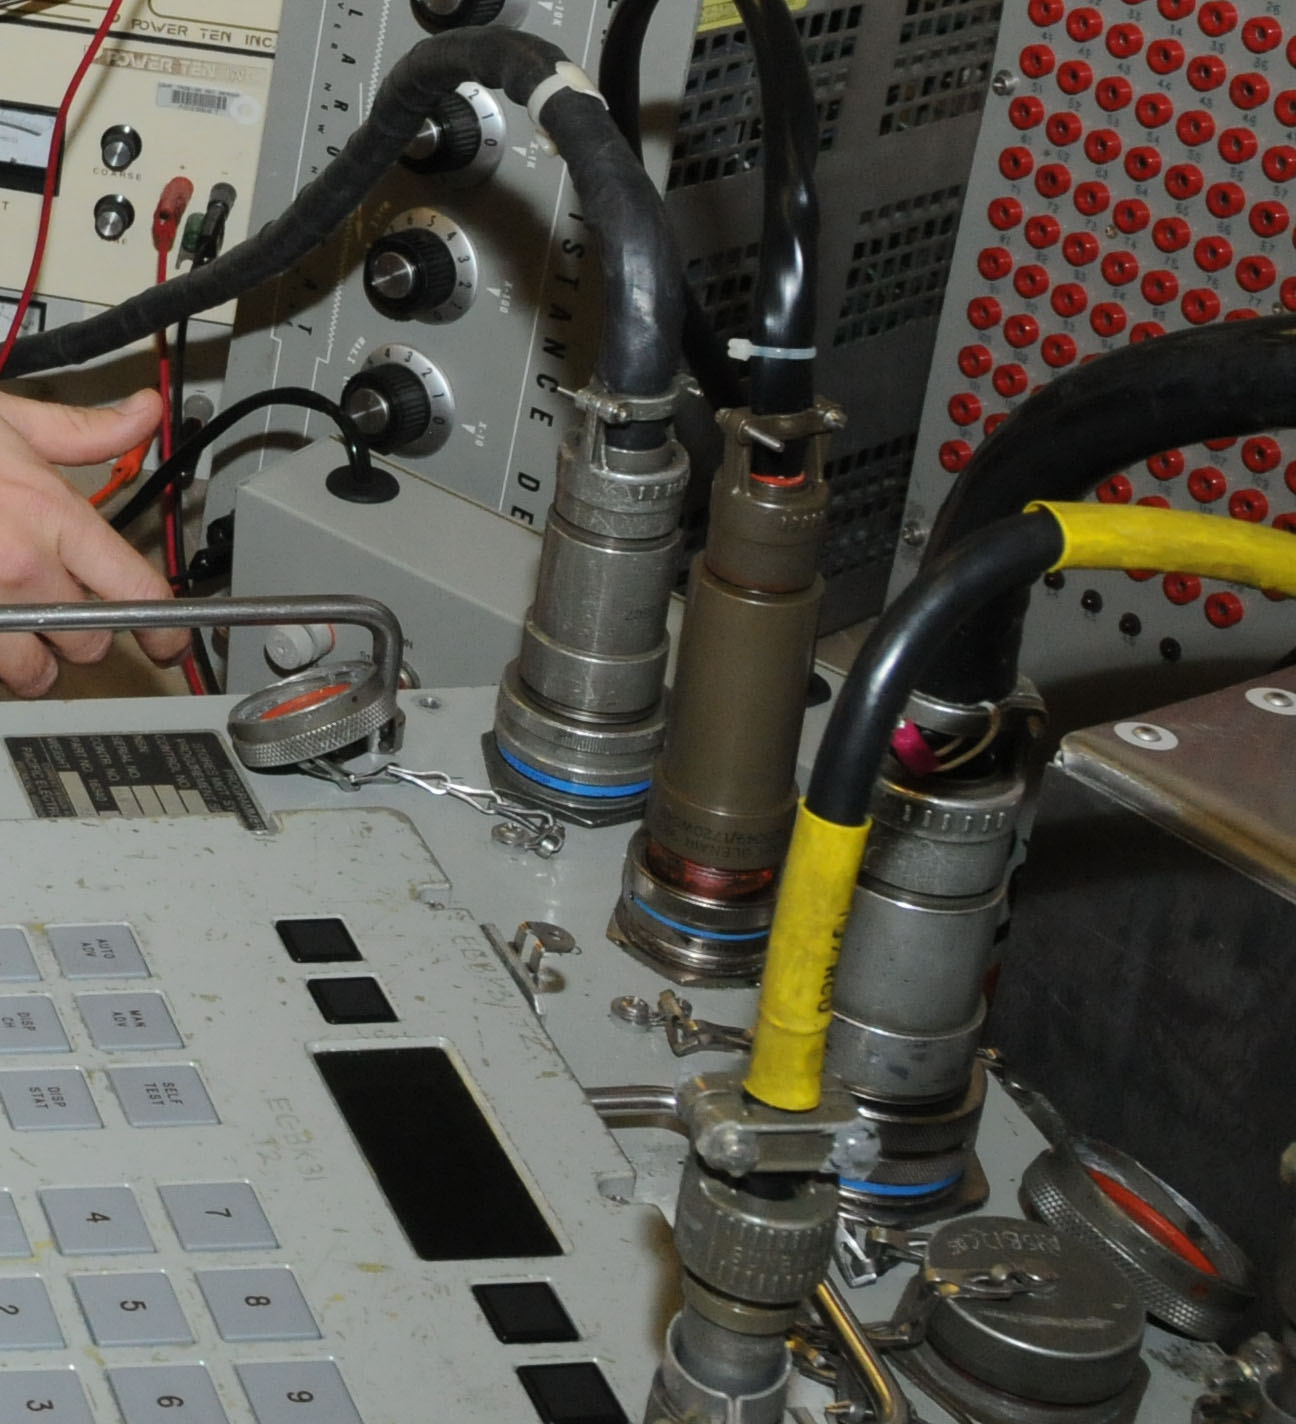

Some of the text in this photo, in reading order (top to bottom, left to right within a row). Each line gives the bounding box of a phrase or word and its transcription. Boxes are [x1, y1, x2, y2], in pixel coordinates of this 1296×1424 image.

[131, 17, 232, 43] POWER TEN
[80, 940, 98, 959] ADV
[96, 937, 117, 961] AUTO
[2, 1016, 15, 1030] CH
[16, 1011, 37, 1033] DISP
[111, 1010, 128, 1029] ADV
[128, 1008, 147, 1030] MAN
[29, 1085, 49, 1111] STAT
[46, 1085, 68, 1109] DISP
[143, 1082, 165, 1107] TEST
[162, 1081, 184, 1106] SELF
[84, 1210, 113, 1225] 4
[203, 1206, 234, 1219] 7
[119, 1298, 148, 1314] 5
[243, 1294, 272, 1309] 8
[25, 1397, 55, 1414] 3
[155, 1394, 186, 1410] 6
[285, 1389, 315, 1405] 9
